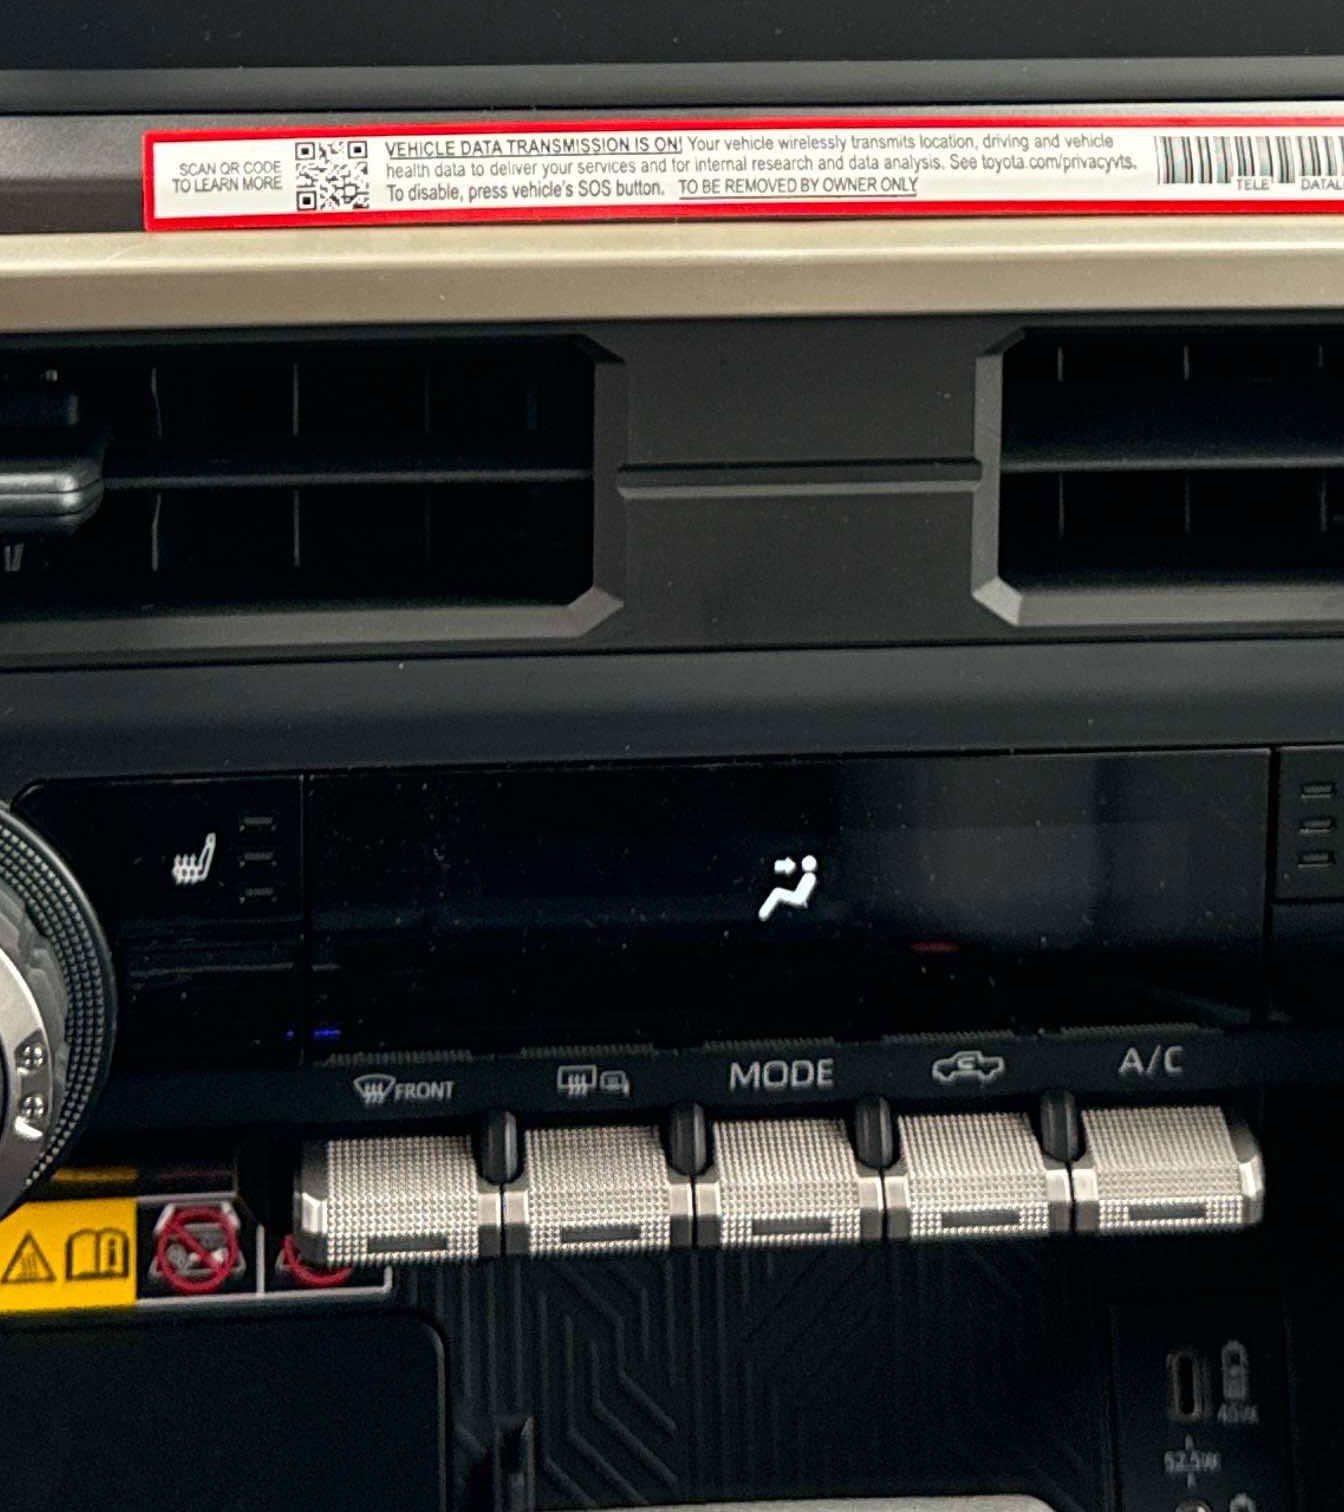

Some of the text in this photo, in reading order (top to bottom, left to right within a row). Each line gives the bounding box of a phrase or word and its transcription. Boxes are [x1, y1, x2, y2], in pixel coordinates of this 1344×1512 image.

[385, 134, 1114, 156] VEHICLE DATA TRANSMISSION IS ON! Your vehicle wirelessly transmits location, driving and vehicle
[178, 160, 282, 176] SCAN QR CODE
[386, 163, 430, 179] health
[434, 162, 466, 177] data
[471, 163, 485, 177] to
[490, 161, 537, 176] deliver
[542, 161, 572, 179] your
[577, 160, 636, 175] services
[641, 158, 667, 173] and
[672, 158, 691, 173] for
[695, 156, 747, 172] internal
[752, 156, 813, 171] research
[818, 155, 844, 170] and
[849, 155, 879, 170] data
[884, 154, 945, 173] analysis.
[950, 153, 978, 170] See
[172, 175, 283, 193] TO LEARN MORE
[386, 176, 919, 203] To disable, press vehicle's SOS button. TO BE REMOVED BY OWNER ONLY
[1236, 178, 1270, 191] TELE
[1118, 1044, 1185, 1076] A/C
[729, 1058, 834, 1090] MODE
[394, 1081, 454, 1101] FRONT
